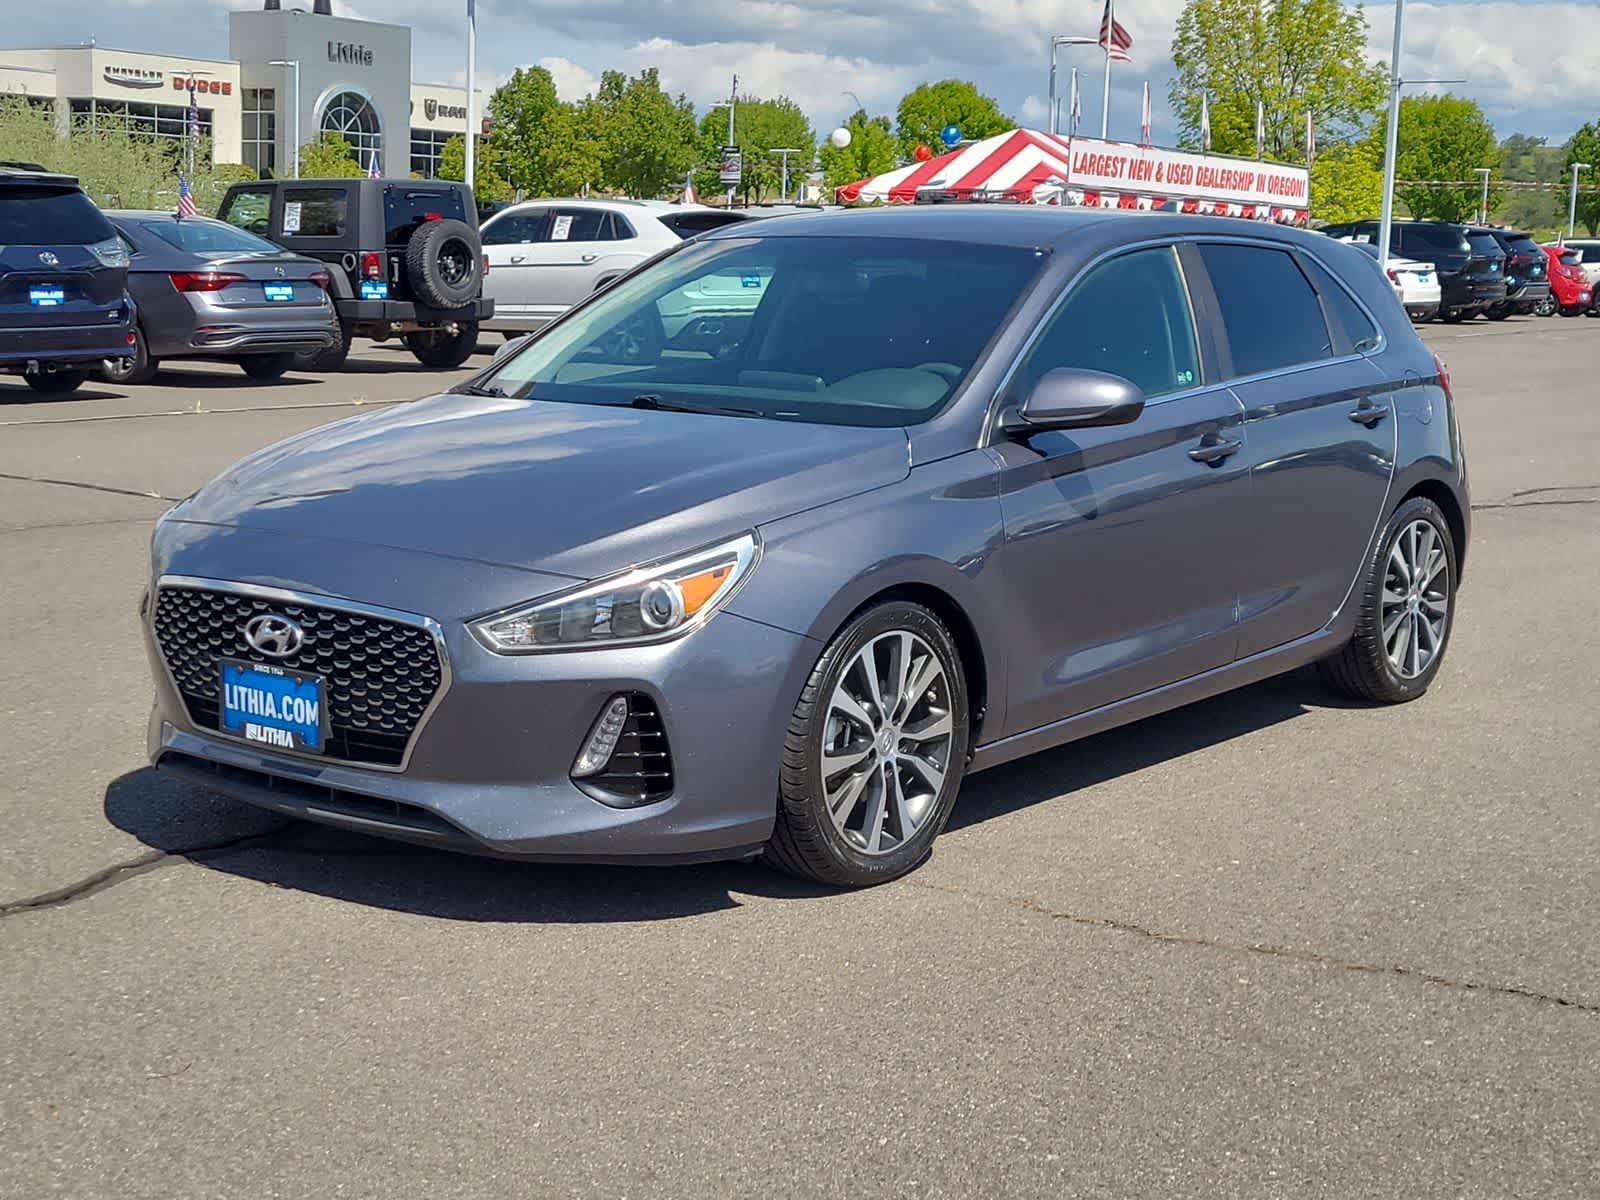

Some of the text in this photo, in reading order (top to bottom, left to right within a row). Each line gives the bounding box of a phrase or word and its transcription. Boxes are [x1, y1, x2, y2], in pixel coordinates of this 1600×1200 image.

[327, 40, 373, 66] Lithia
[105, 66, 163, 79] CHRYSLER
[173, 77, 232, 95] DODGE
[1072, 152, 1306, 198] LARGEST NEW & USED DEALERSHIP IN OREGON!
[224, 683, 319, 727] LITHIA.COM
[257, 725, 294, 748] LITHIA
